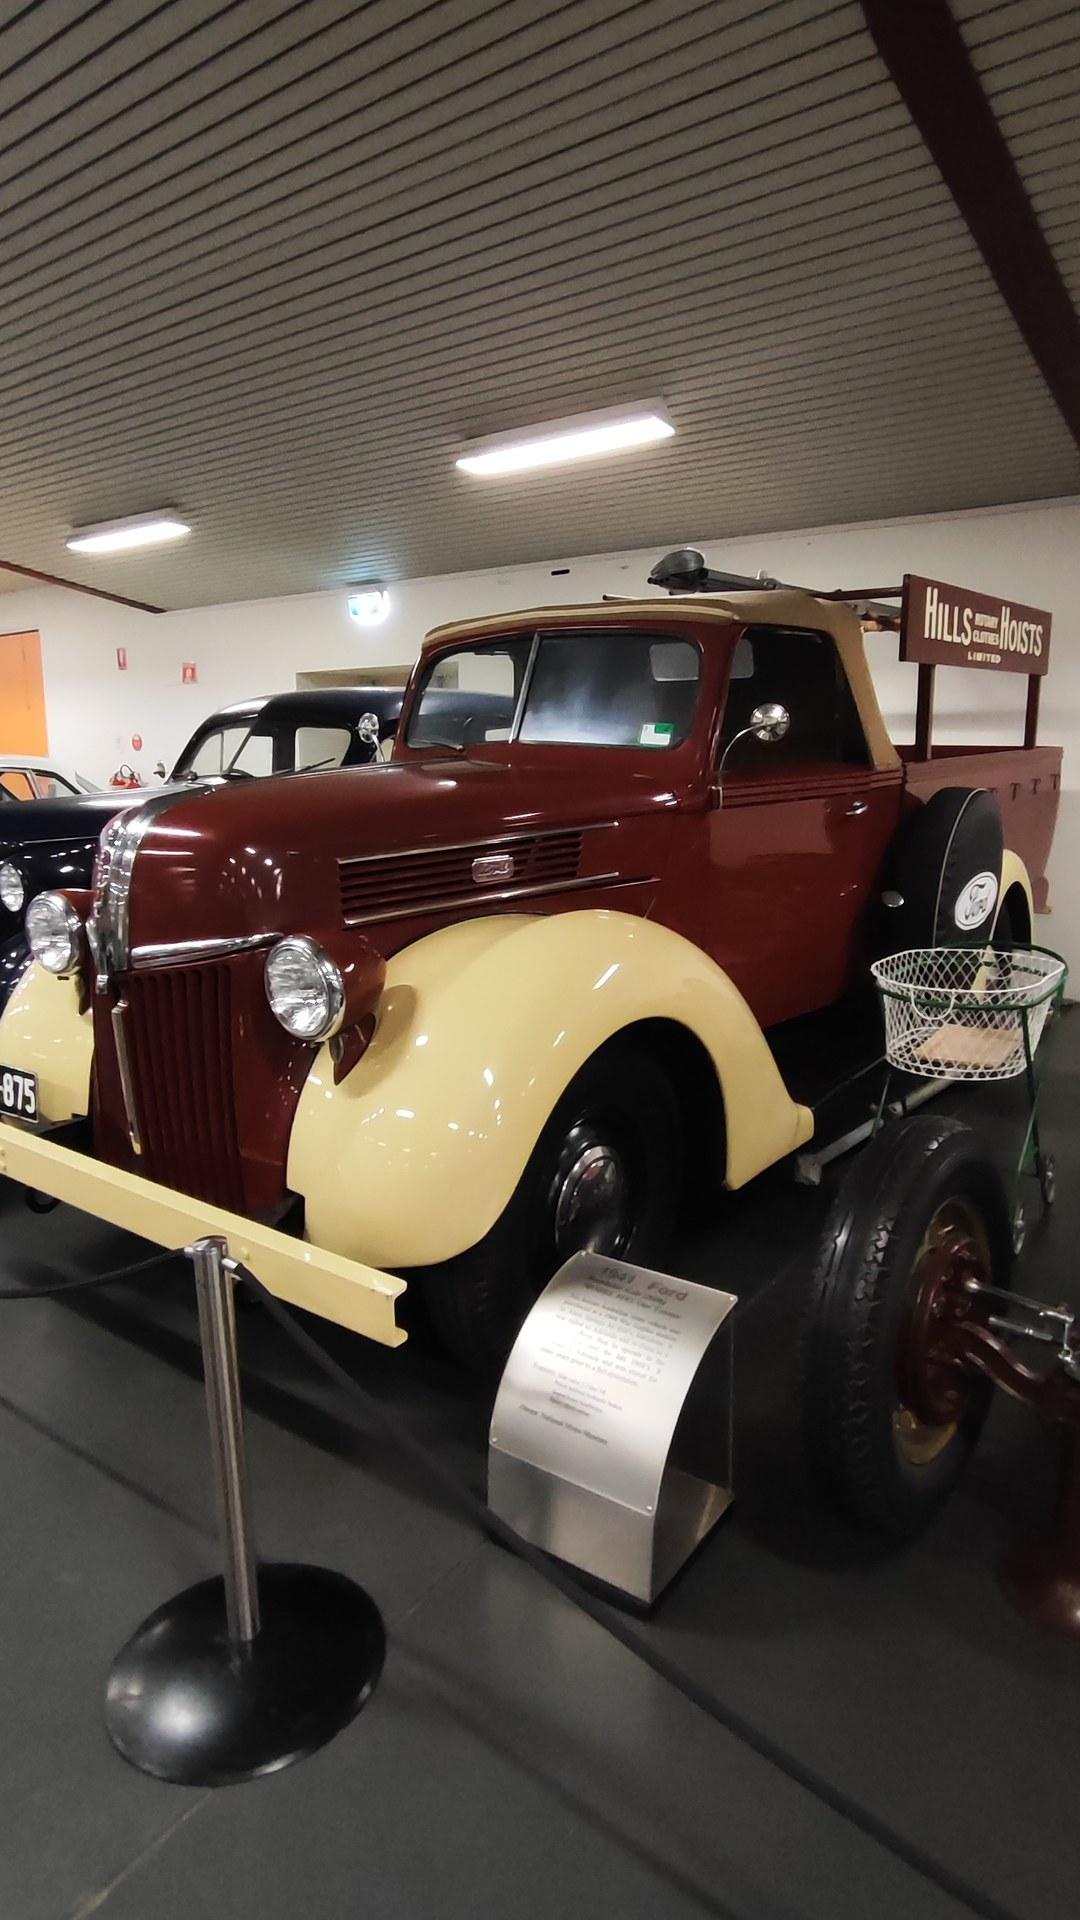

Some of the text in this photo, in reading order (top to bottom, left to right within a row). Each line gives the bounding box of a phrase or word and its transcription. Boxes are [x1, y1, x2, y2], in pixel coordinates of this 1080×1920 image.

[924, 586, 973, 646] HILLS
[973, 629, 999, 646] CLOTHES
[1000, 606, 1043, 657] HOISTS
[968, 651, 1001, 664] LIMITED
[963, 882, 989, 921] Ford
[647, 1281, 688, 1302] Ford
